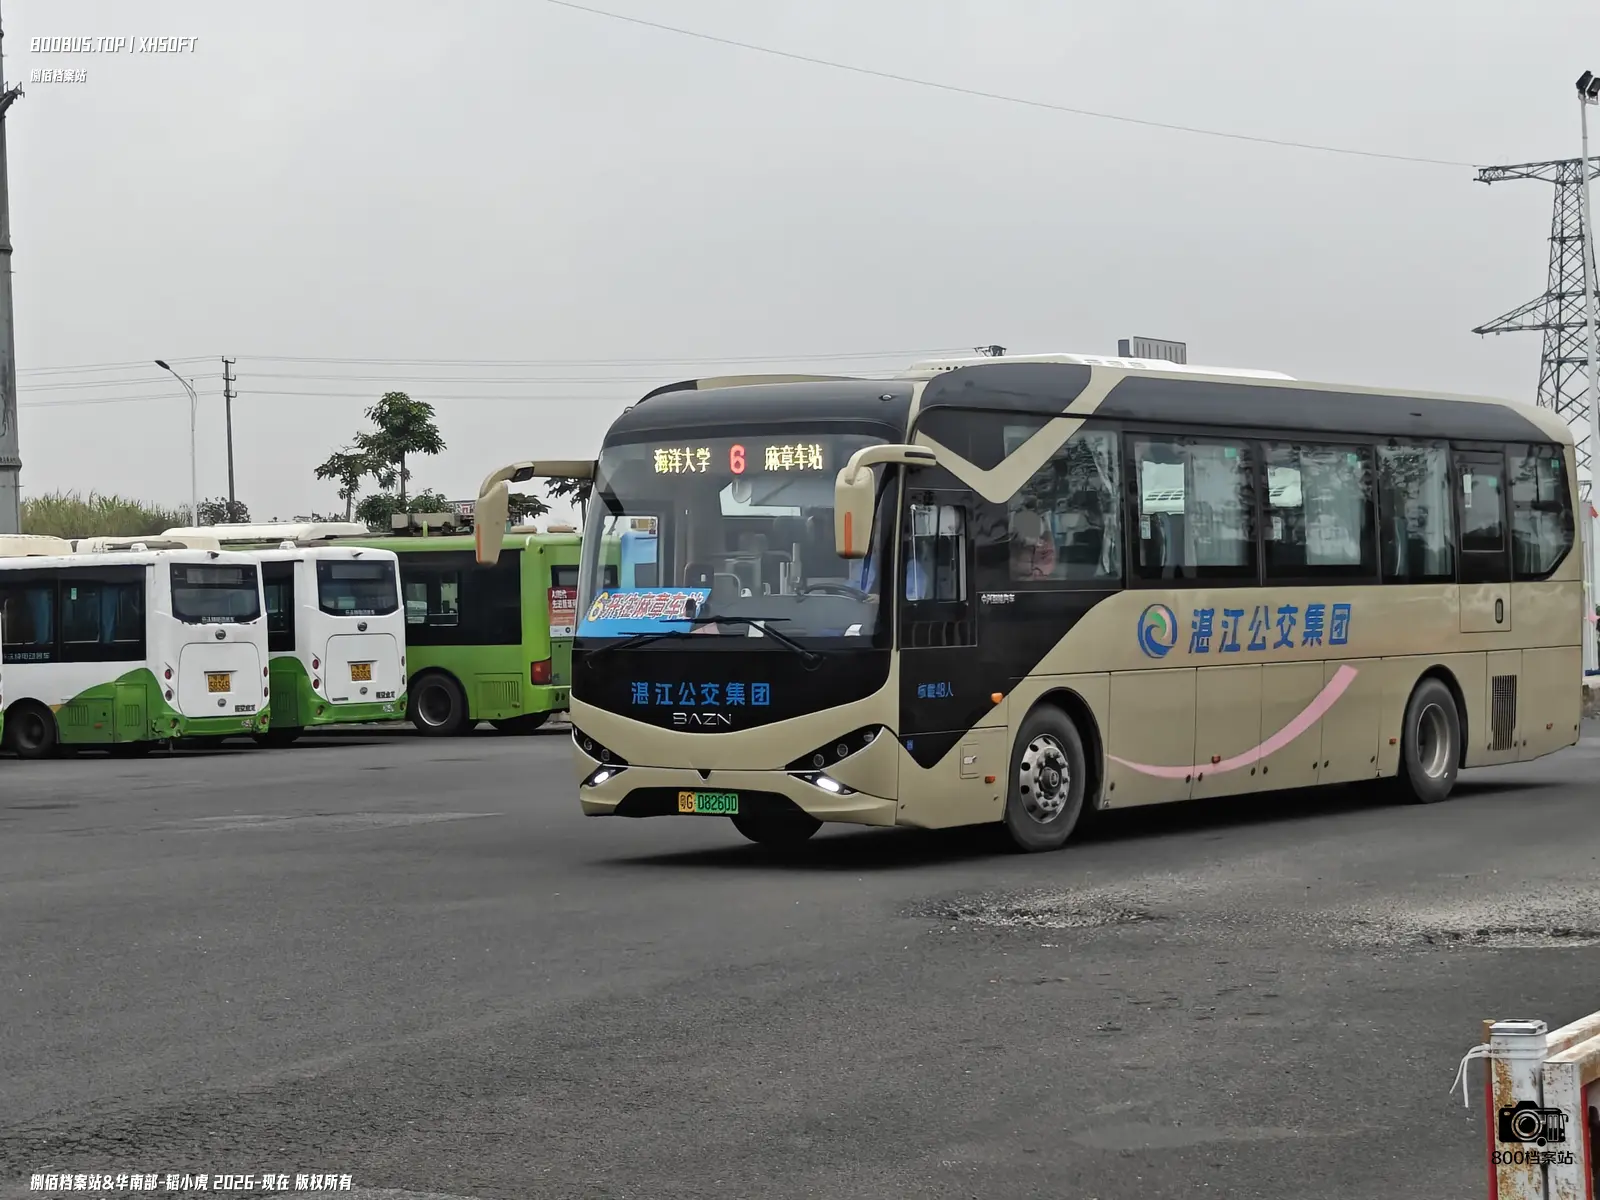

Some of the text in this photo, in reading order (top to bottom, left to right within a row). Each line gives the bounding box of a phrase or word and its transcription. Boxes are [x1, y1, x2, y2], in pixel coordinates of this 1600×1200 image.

[653, 443, 824, 475] 海洋大学 6 麻章车站
[588, 591, 609, 622] 6
[1188, 602, 1352, 654] 湛江公交集团
[631, 681, 771, 706] 湛江公交集团
